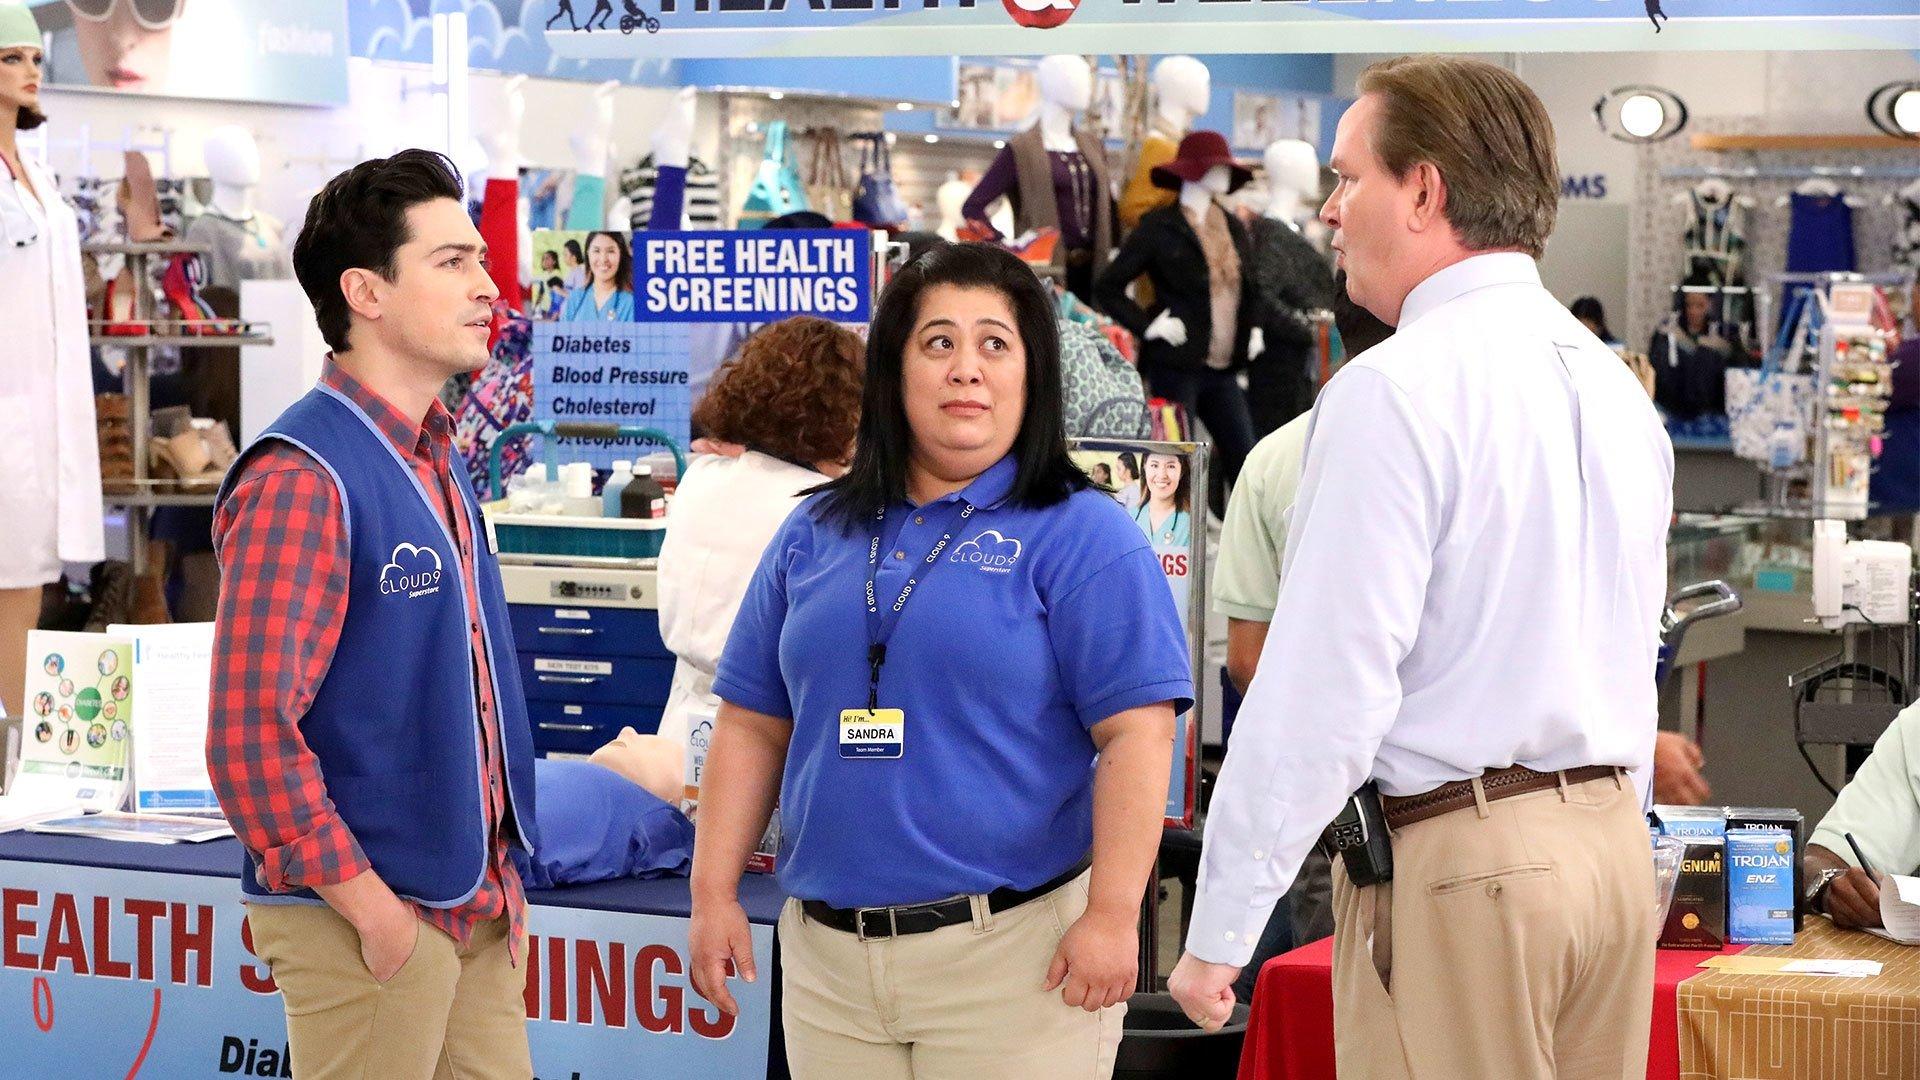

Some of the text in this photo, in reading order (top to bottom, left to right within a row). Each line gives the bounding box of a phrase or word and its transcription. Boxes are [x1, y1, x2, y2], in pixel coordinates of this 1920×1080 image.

[646, 238, 855, 274] FREE HEALTH
[646, 276, 859, 313] SCREENINGS
[552, 335, 631, 354] Diabetes
[552, 366, 689, 385] Blood Pressure
[552, 397, 656, 415] Cholesterol
[926, 533, 951, 563] CLOUD 9
[979, 565, 1012, 574] Superstore
[1157, 554, 1188, 576] GS
[408, 586, 440, 599] Superstore
[866, 580, 876, 606] CLOUD
[893, 579, 917, 612] CLOUD 9
[847, 728, 895, 740] SANDRA
[1676, 828, 1714, 836] TROJAN
[1679, 860, 1722, 873] GNUM
[1732, 855, 1791, 868] TROJAN
[1746, 874, 1776, 884] ENZ
[2, 887, 215, 988] EALTH
